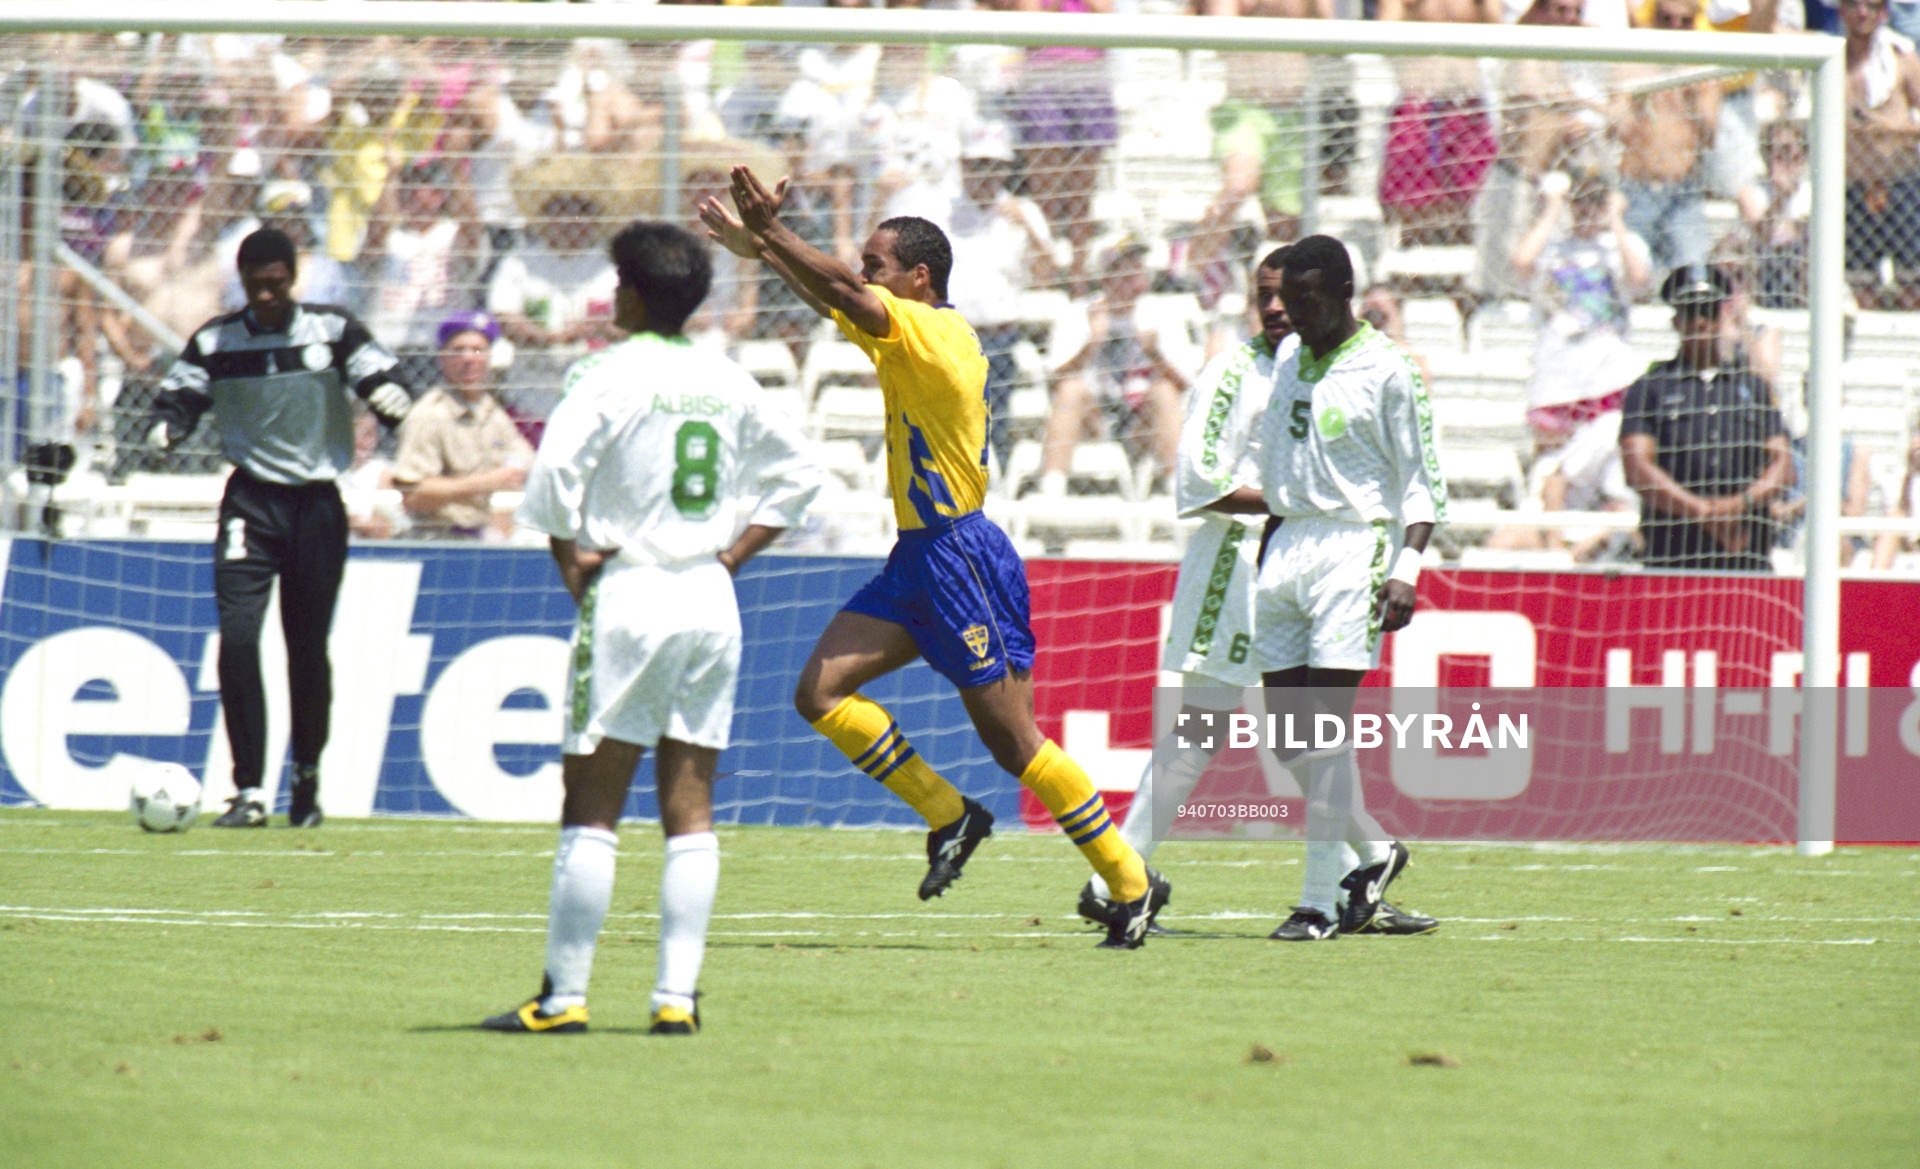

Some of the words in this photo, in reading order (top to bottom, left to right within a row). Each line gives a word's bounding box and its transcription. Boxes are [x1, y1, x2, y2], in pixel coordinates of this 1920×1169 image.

[1288, 400, 1312, 440] 5
[671, 420, 720, 517] 8
[225, 518, 248, 560] 1
[1228, 632, 1251, 664] 6
